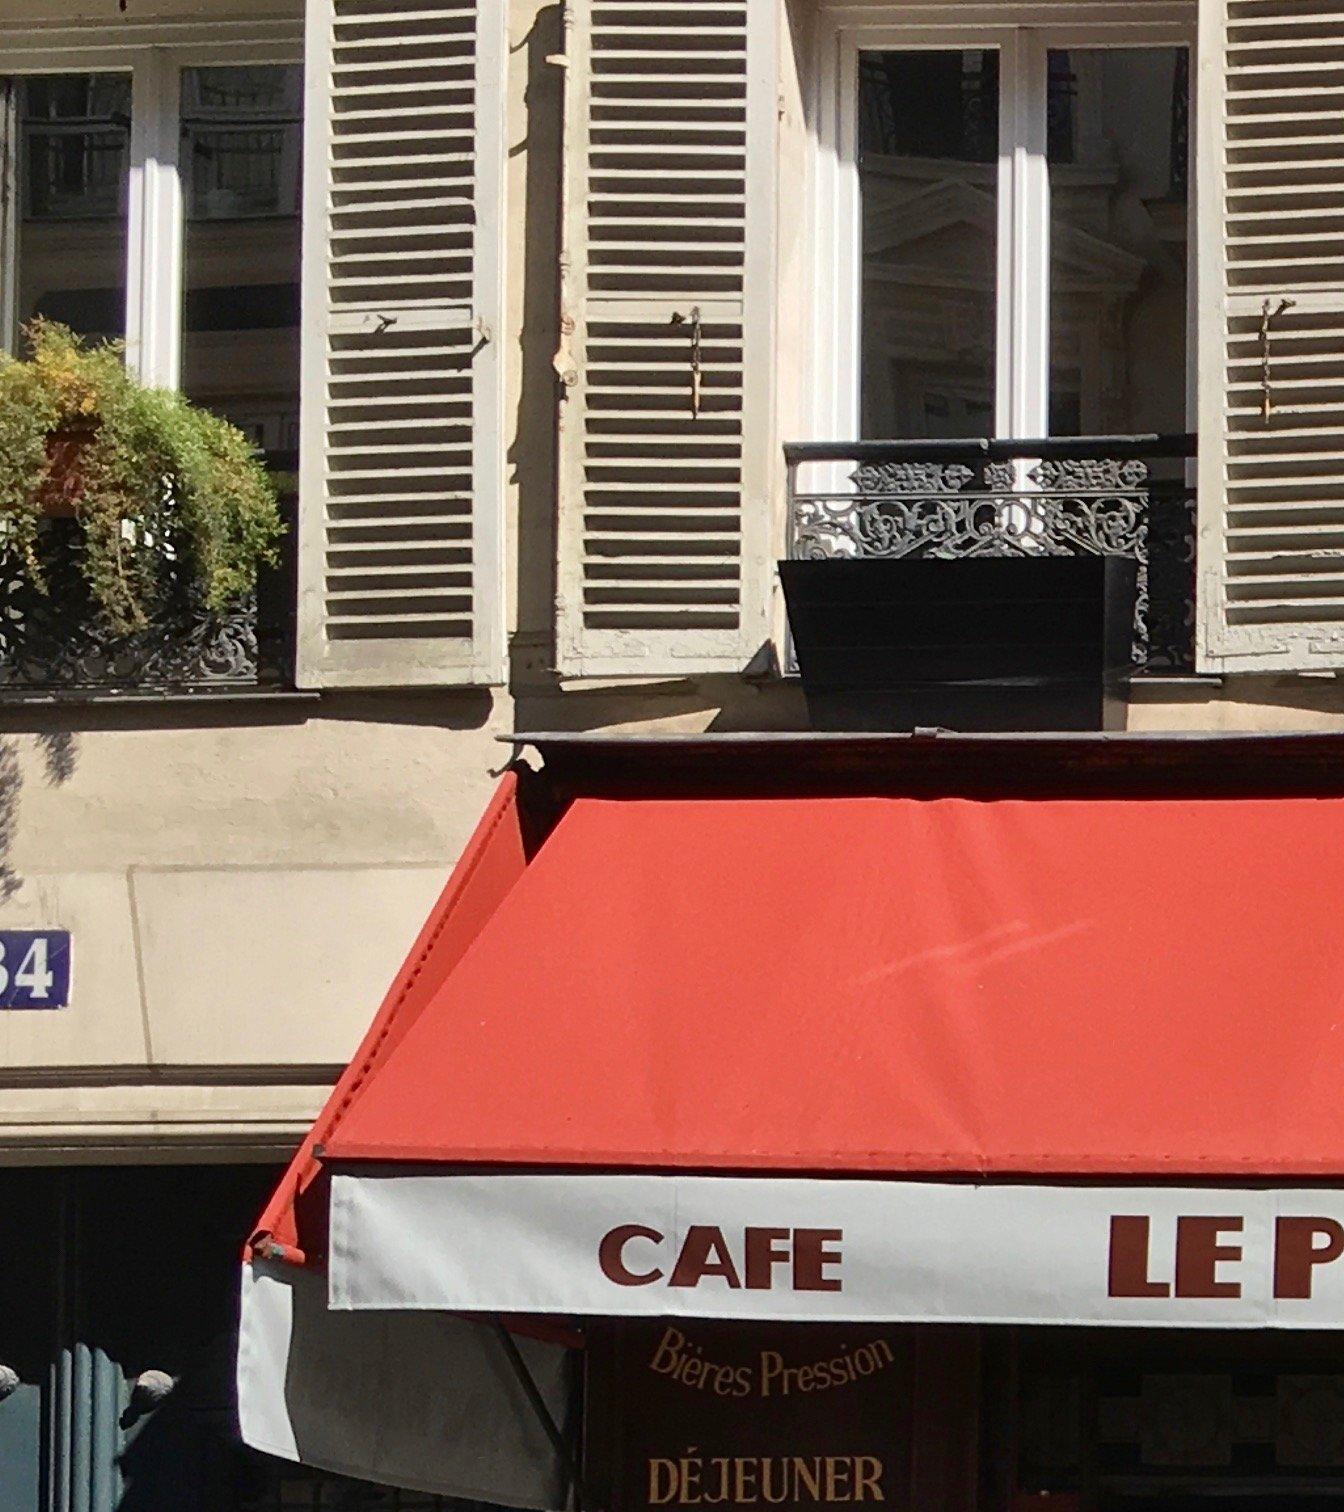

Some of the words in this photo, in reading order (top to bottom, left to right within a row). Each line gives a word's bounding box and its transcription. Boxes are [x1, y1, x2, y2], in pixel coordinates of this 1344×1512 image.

[0, 939, 53, 999] 4
[598, 1224, 843, 1293] CAFE
[1107, 1214, 1244, 1299] LE
[760, 1338, 895, 1397] Pression
[648, 1447, 885, 1504] DÉJEUNER
